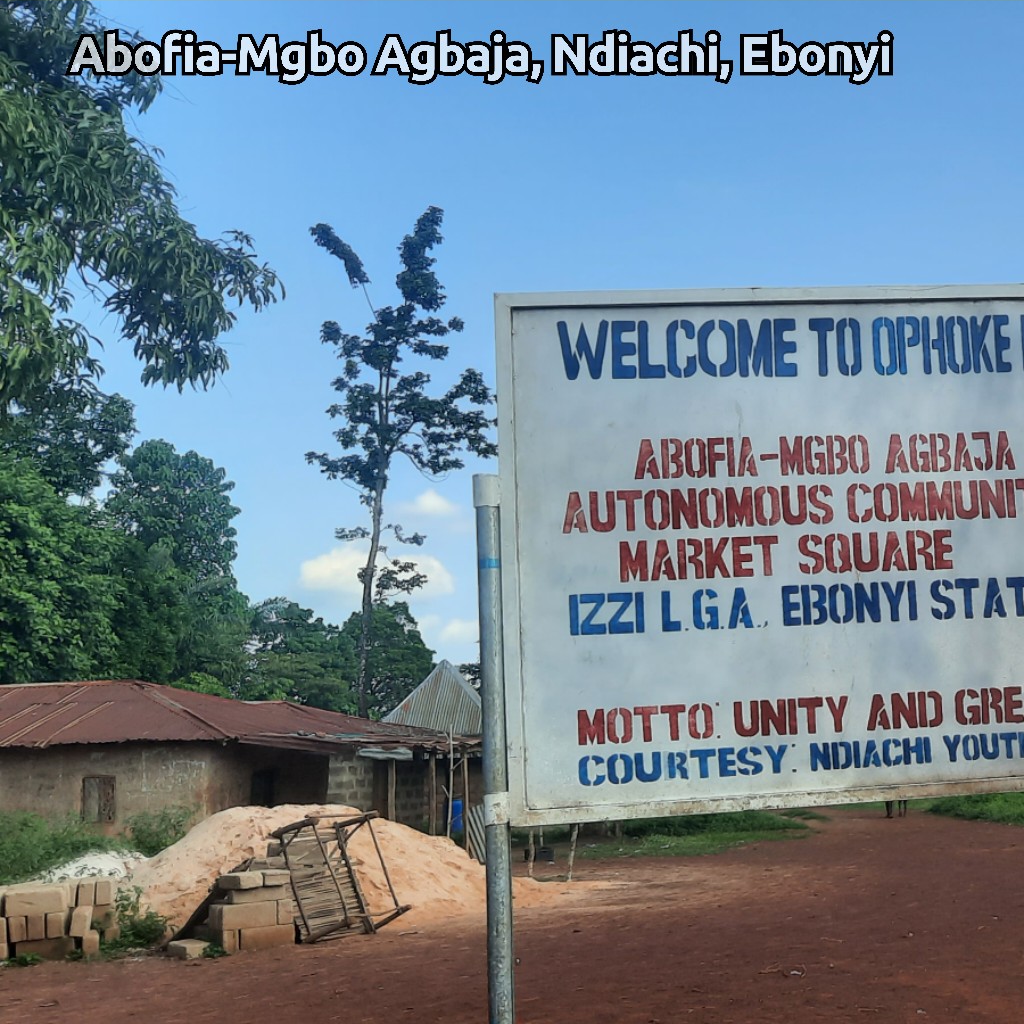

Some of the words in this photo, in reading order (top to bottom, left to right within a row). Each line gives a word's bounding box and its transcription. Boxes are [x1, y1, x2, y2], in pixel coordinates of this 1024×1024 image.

[557, 317, 798, 381] WELCOME
[809, 317, 861, 376] TO
[872, 313, 1013, 375] OPHOKE
[634, 433, 870, 480] ABOFIA-MGBO
[884, 430, 1016, 473] AGBAJA
[561, 483, 836, 534] AUTONOMOUS
[618, 534, 779, 583] MARKET
[797, 529, 955, 572] SQUARE
[568, 591, 646, 636] IZZI
[781, 580, 918, 627] EBONYI
[577, 700, 723, 746] MOTTO:
[733, 695, 851, 739] UNITY
[866, 689, 944, 732] AND
[577, 742, 798, 787] COURTESY:
[809, 735, 933, 772] NDIACHI
